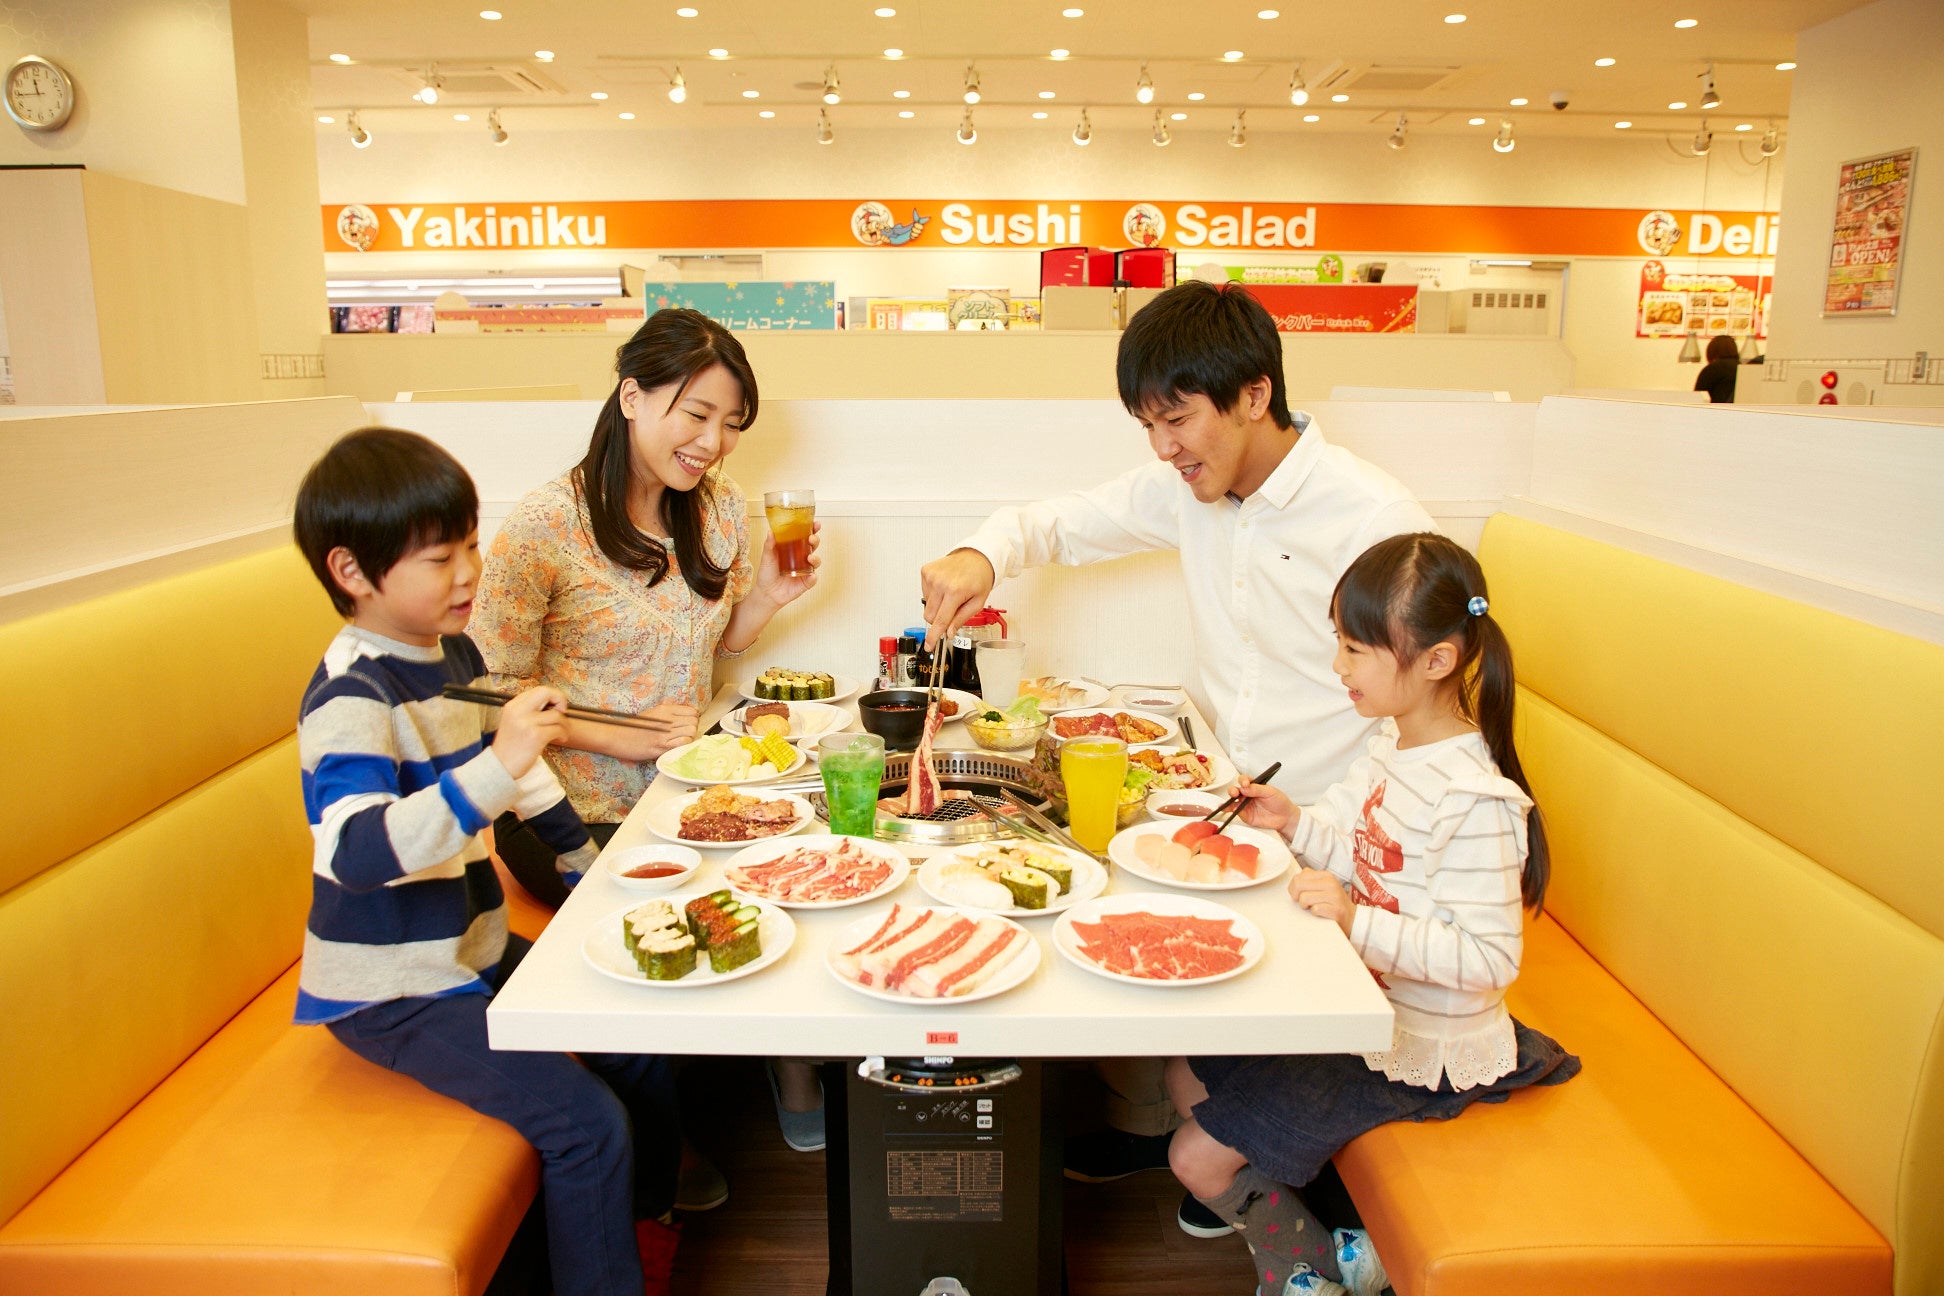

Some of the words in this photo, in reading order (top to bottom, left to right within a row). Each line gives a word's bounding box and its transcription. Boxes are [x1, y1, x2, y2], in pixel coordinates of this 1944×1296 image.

[33, 66, 40, 76] 12
[38, 112, 44, 121] 6
[388, 206, 606, 247] Yakiniku
[940, 204, 1081, 244] Sushi
[1175, 206, 1316, 248] Salad
[1688, 214, 1780, 255] Deli
[964, 300, 995, 312] ソフト
[923, 1056, 953, 1065] SHINPO
